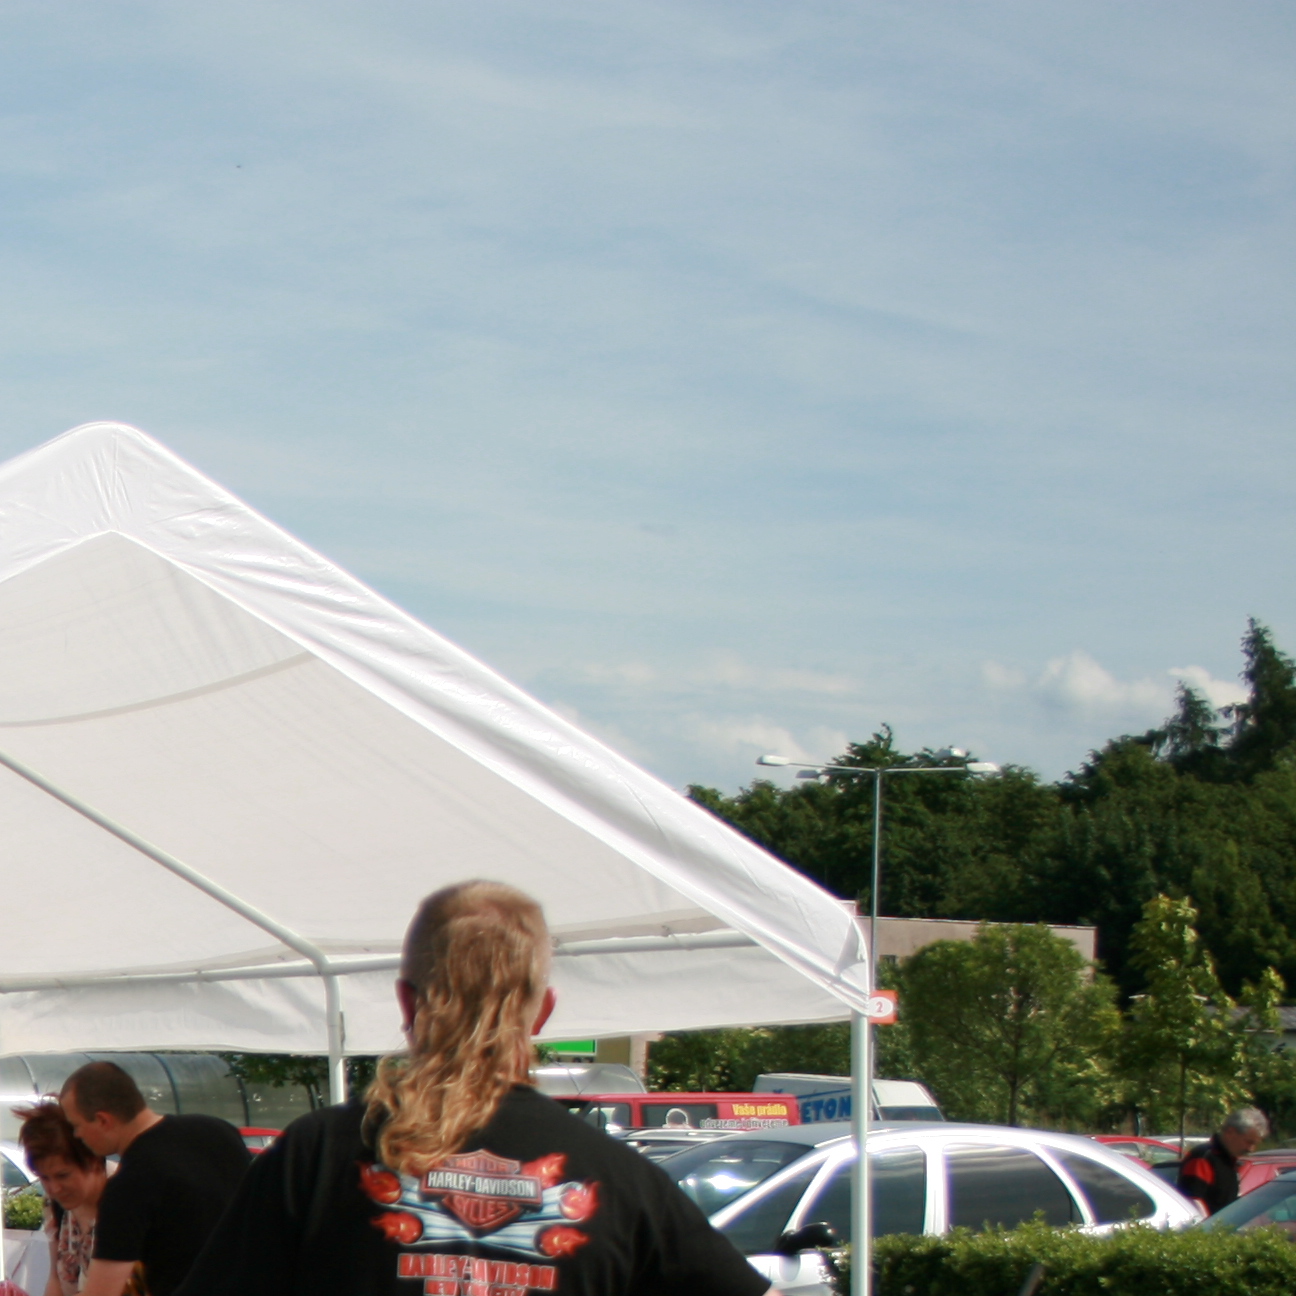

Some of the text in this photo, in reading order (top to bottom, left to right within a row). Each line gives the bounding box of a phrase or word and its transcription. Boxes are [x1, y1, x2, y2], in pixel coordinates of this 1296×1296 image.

[800, 1095, 852, 1124] ETON
[428, 1171, 535, 1198] HARLEY-DAVIDSON
[397, 1253, 555, 1290] HARLEY-DAVIDSON
